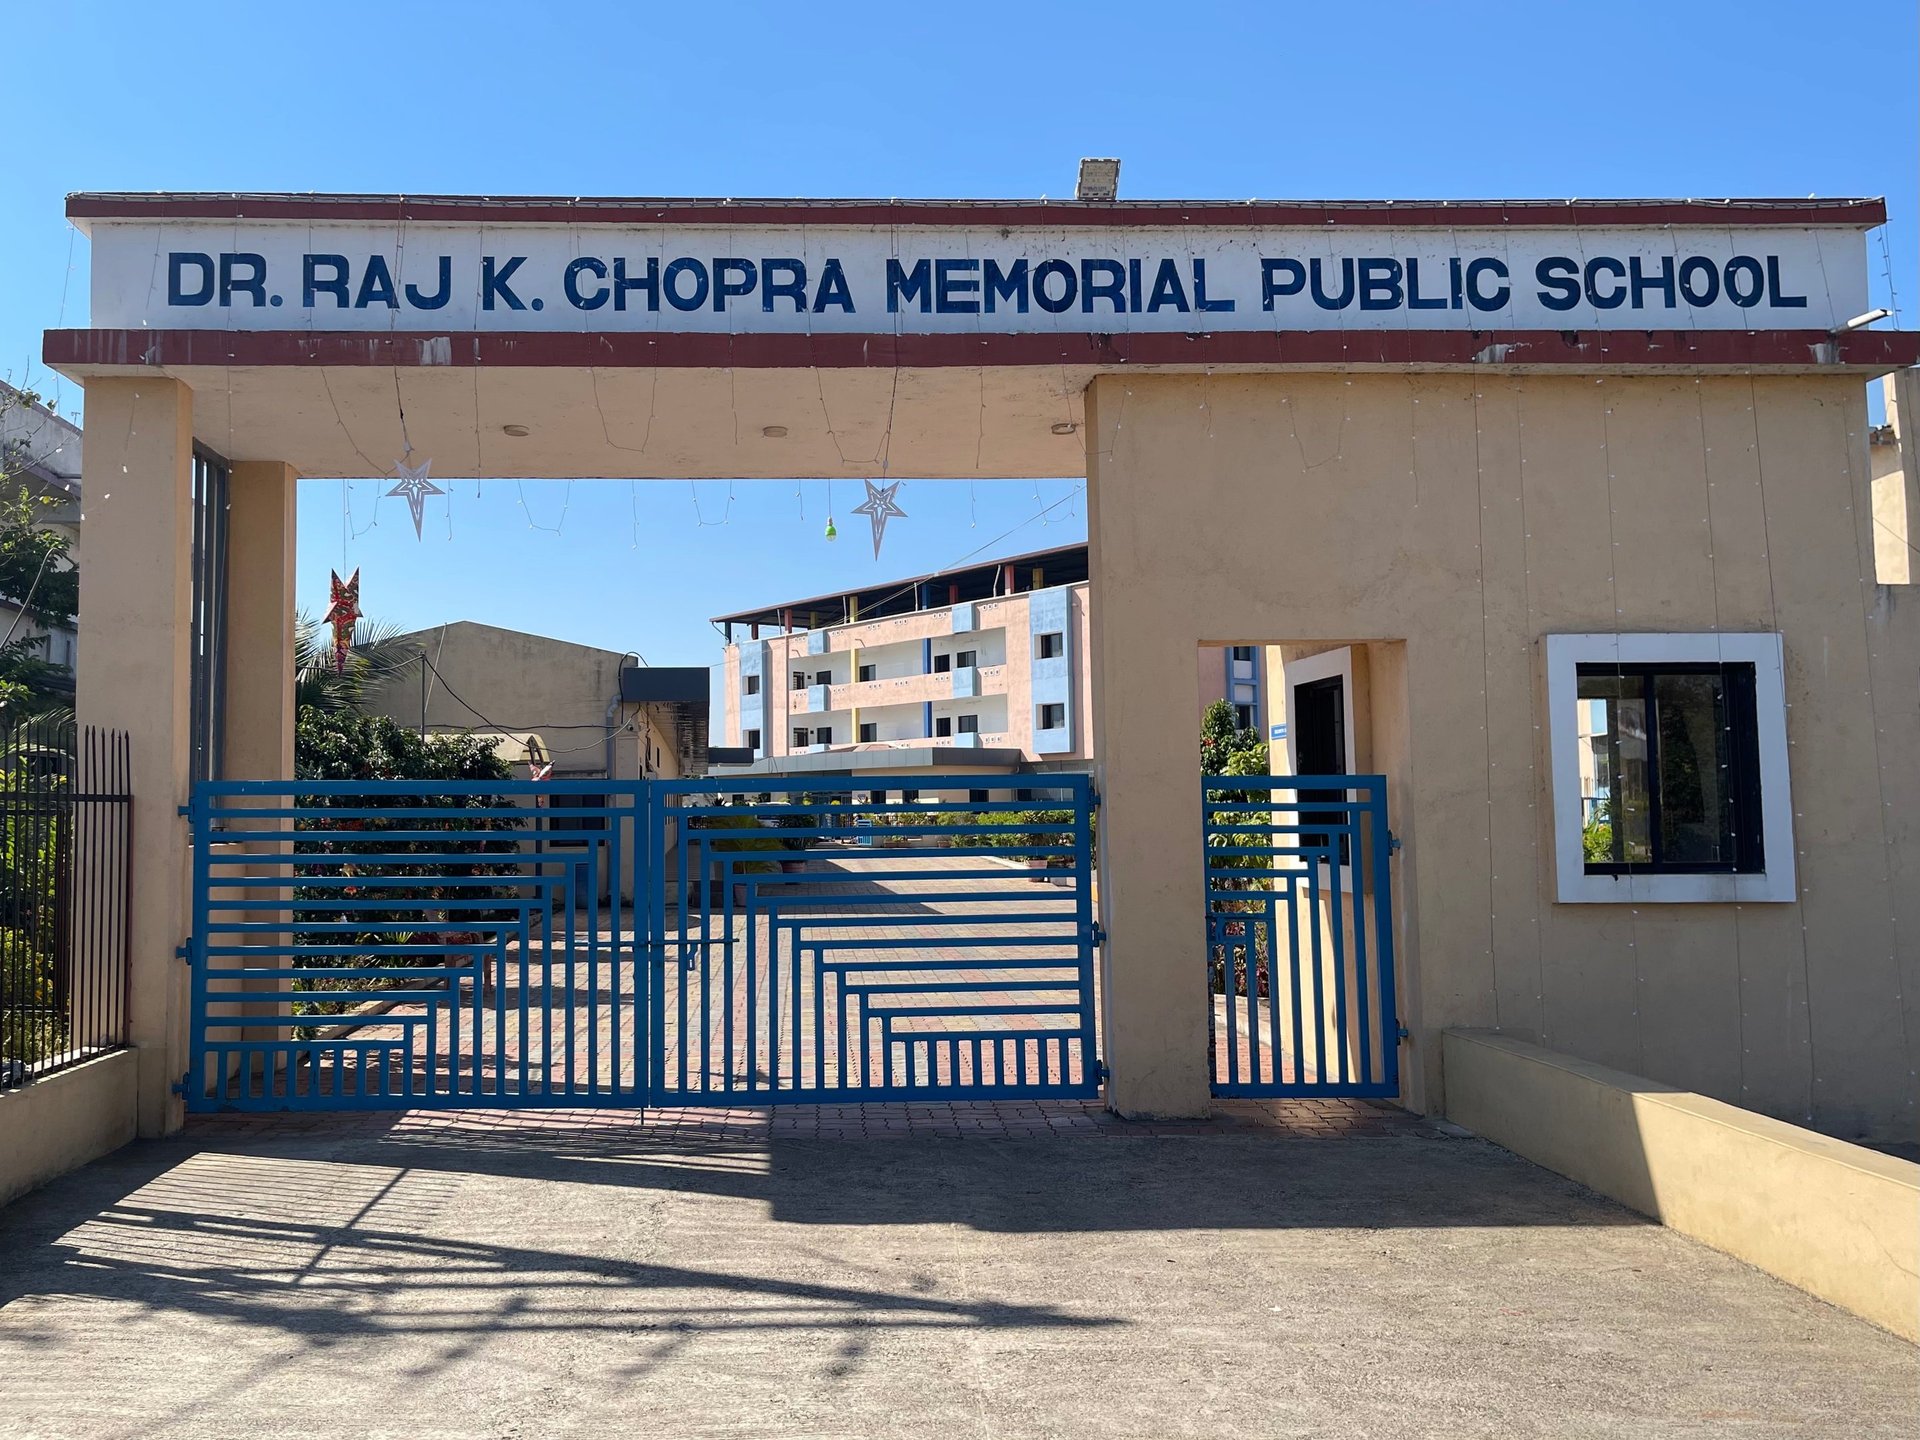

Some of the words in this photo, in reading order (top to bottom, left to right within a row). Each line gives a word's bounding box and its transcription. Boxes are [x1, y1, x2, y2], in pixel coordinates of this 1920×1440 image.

[168, 253, 283, 307] DR.
[303, 255, 451, 310] RAJ
[483, 257, 543, 311] K.
[563, 257, 855, 312] CHOPRA
[887, 257, 1235, 312] MEMORIAL
[1262, 257, 1511, 312] PUBLIC
[1536, 256, 1807, 310] SCHOOL
